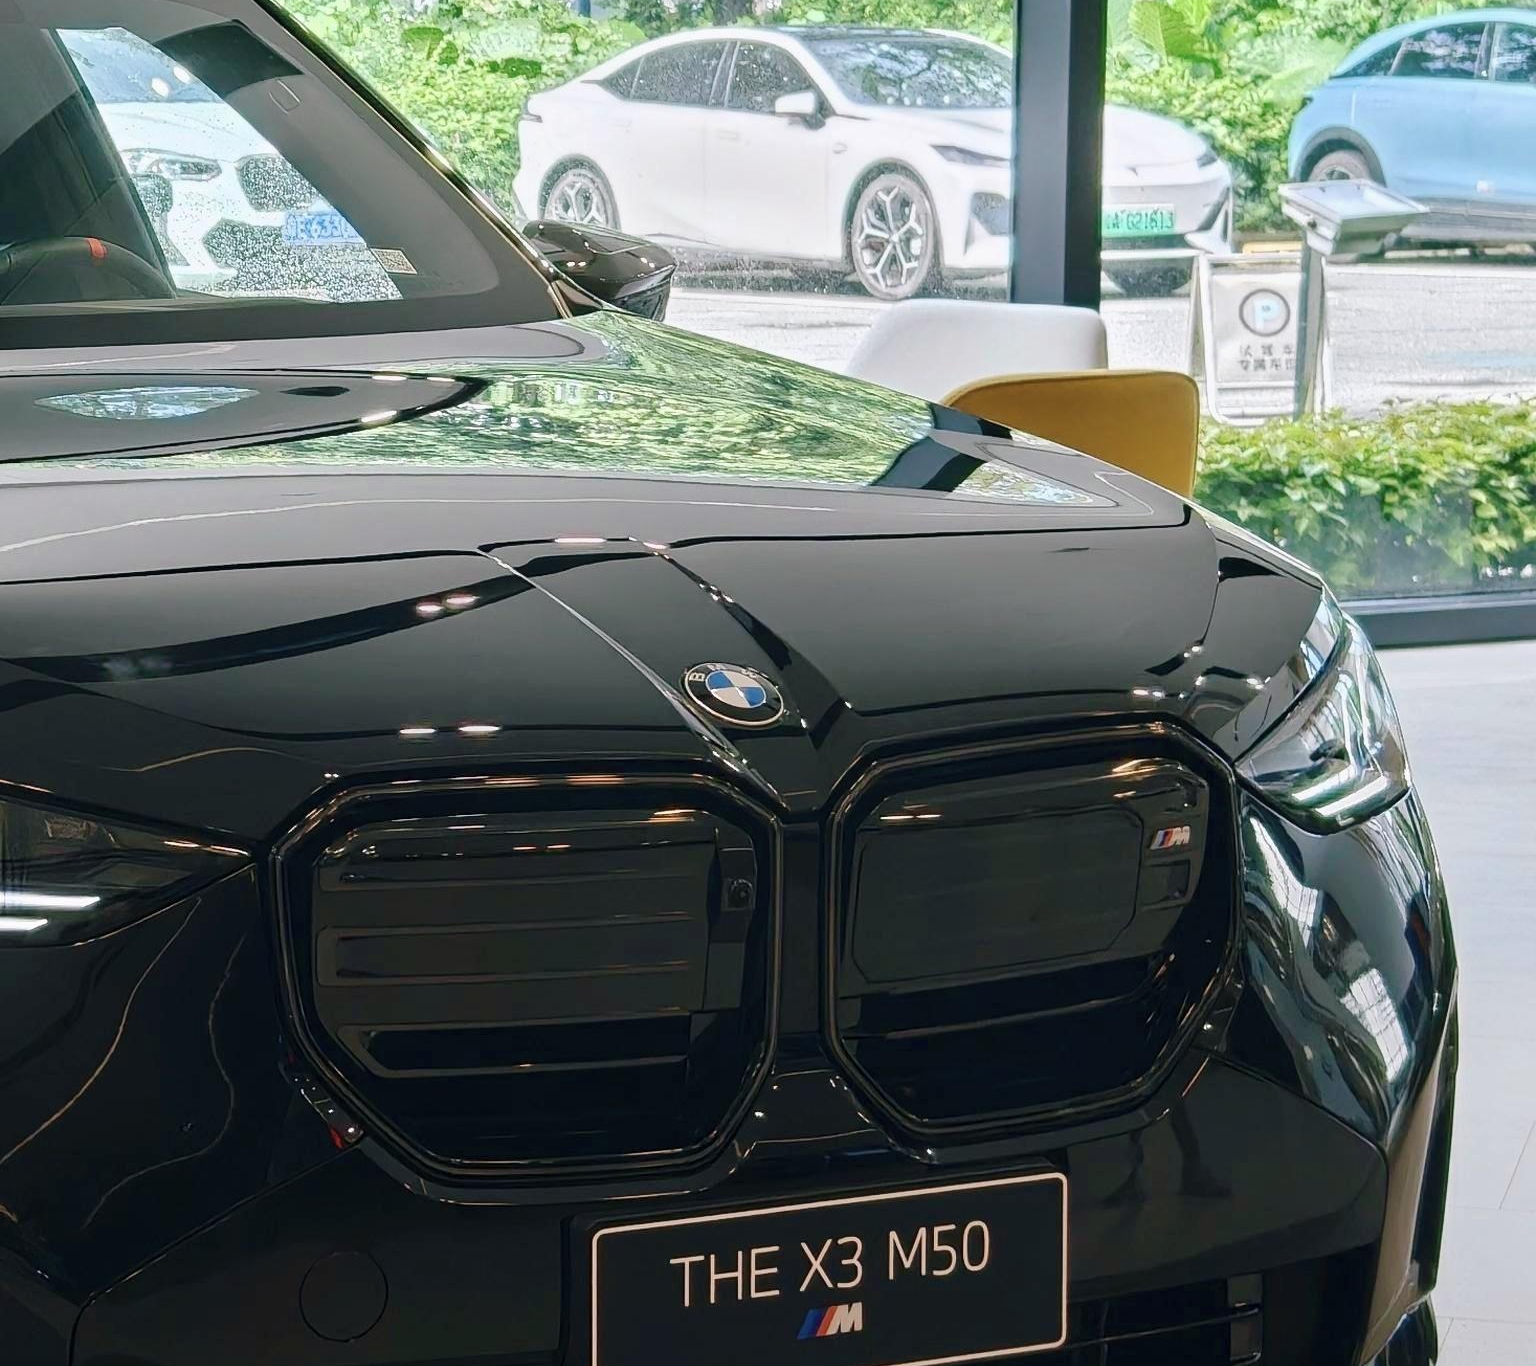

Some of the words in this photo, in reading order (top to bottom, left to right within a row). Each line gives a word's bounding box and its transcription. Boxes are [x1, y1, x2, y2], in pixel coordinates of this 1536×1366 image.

[669, 1245, 780, 1307] THE
[799, 1237, 863, 1292] X3
[888, 1220, 990, 1281] M50
